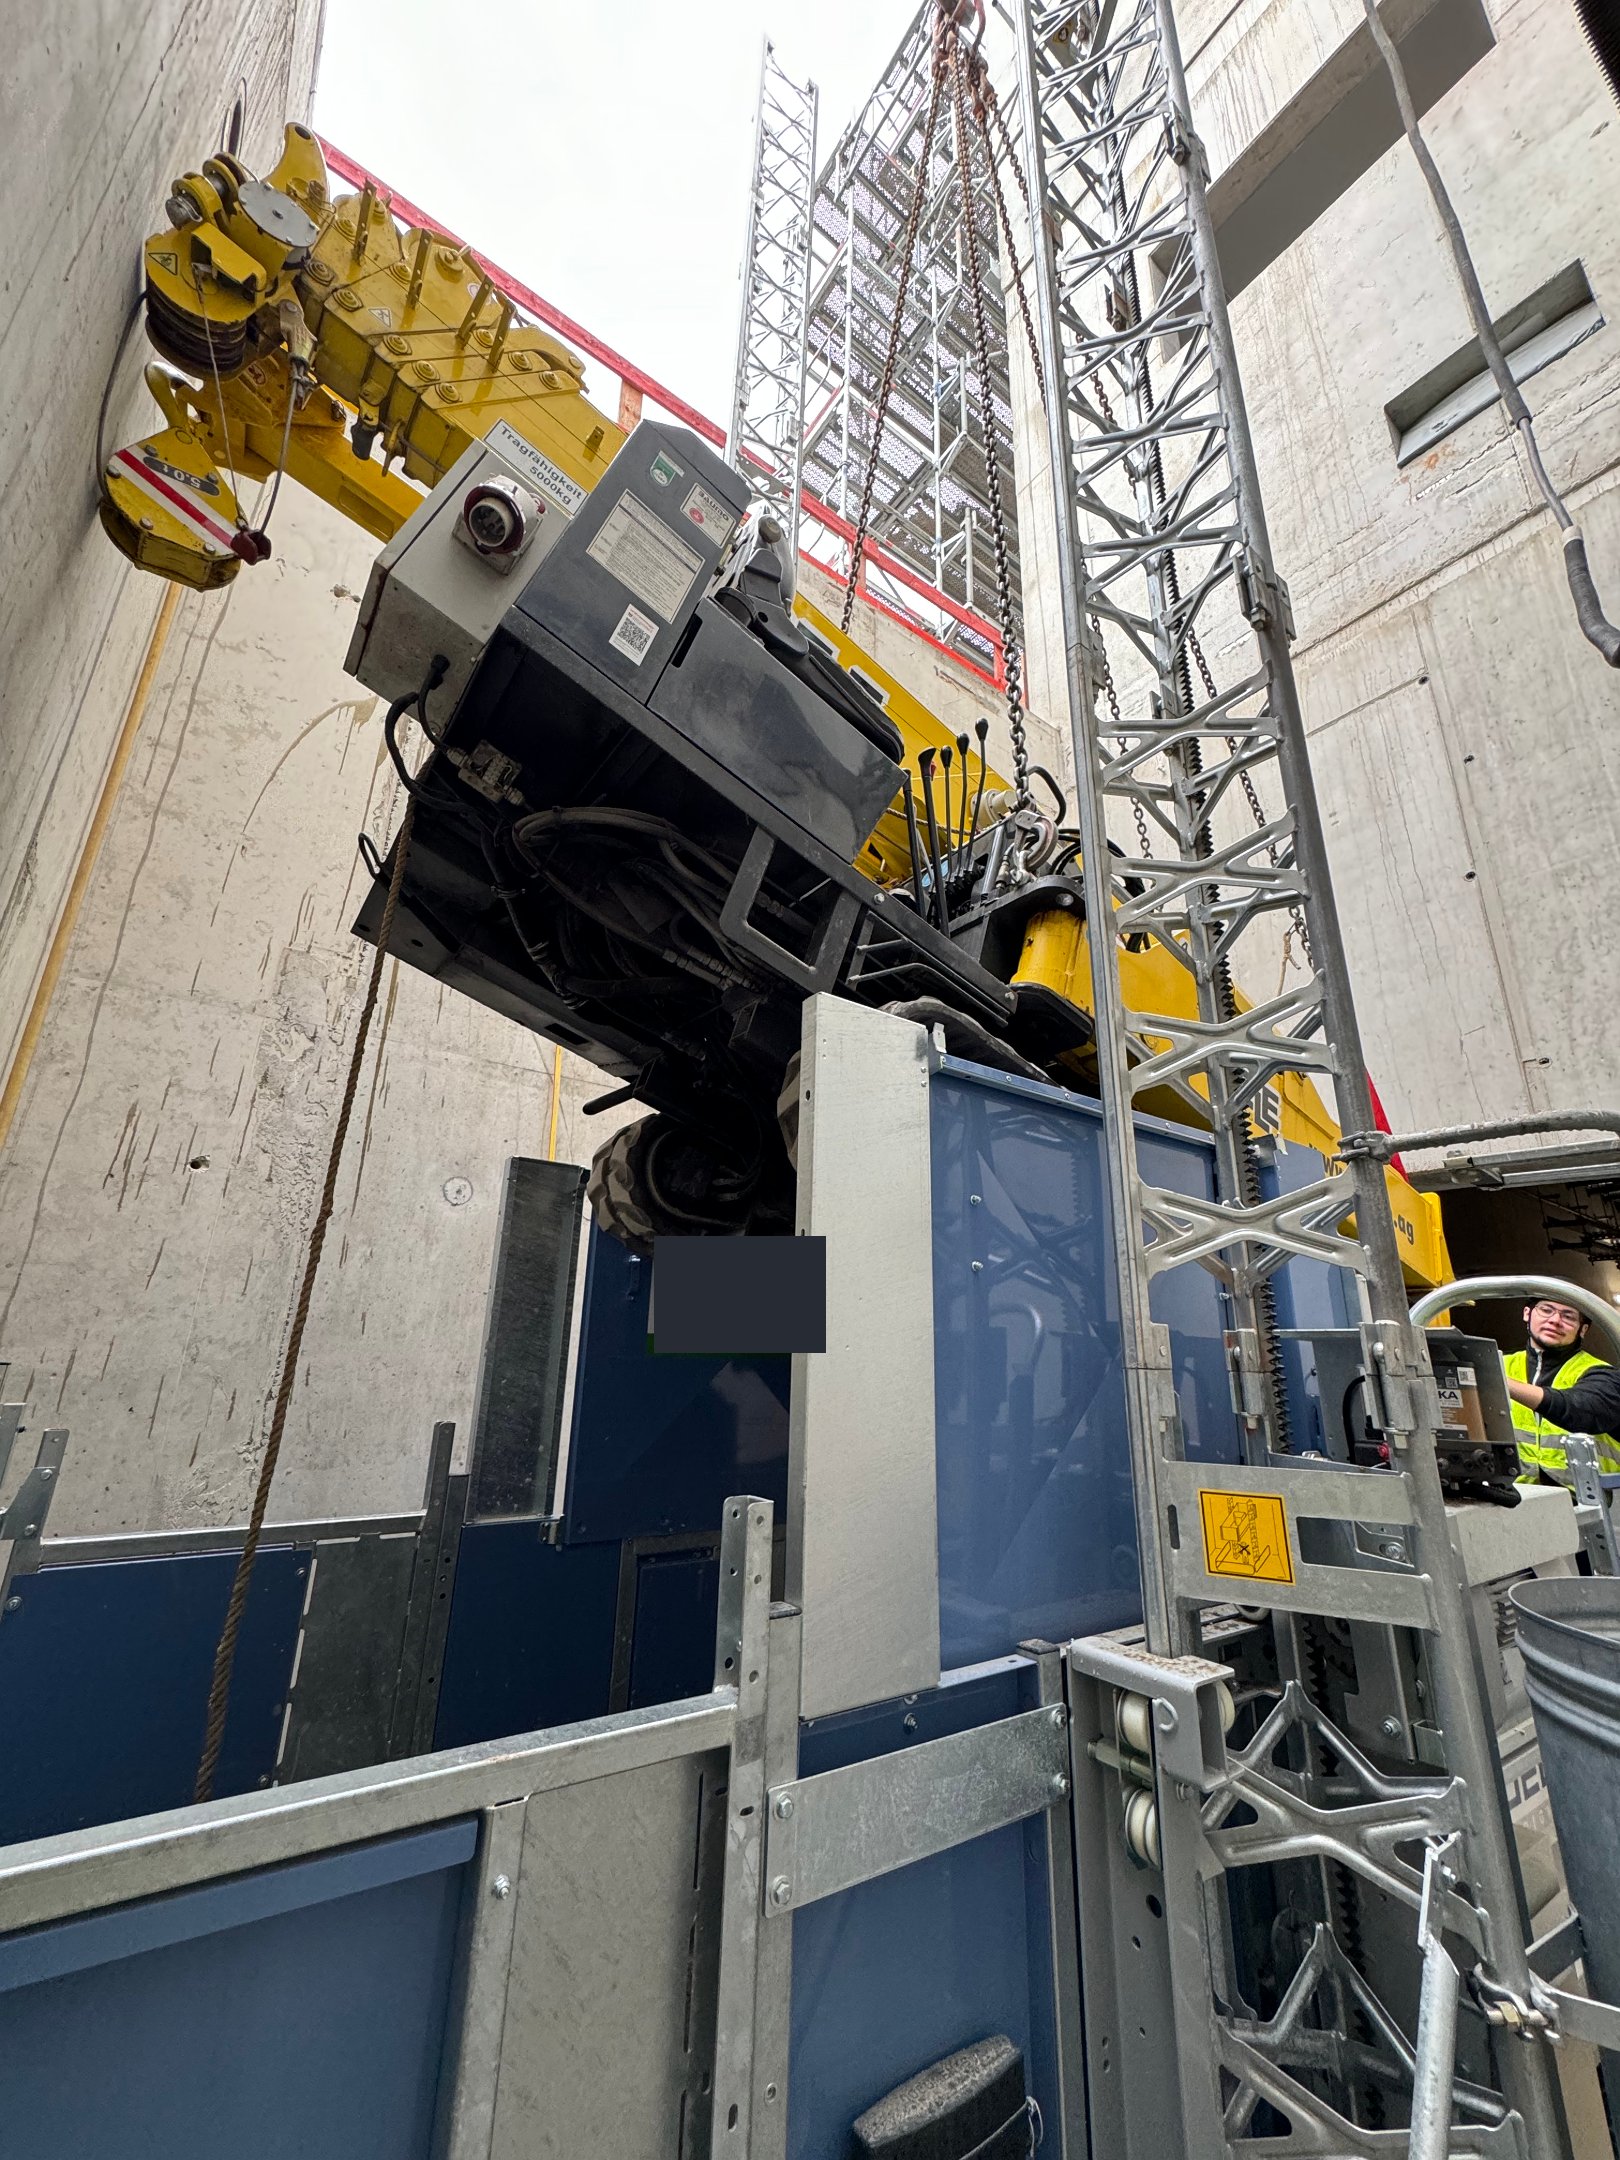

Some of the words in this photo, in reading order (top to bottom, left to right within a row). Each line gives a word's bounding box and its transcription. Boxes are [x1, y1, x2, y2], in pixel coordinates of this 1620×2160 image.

[175, 470, 201, 489] 5.0
[501, 425, 583, 500] Tragfähigkeit
[529, 466, 572, 505] 5000kg
